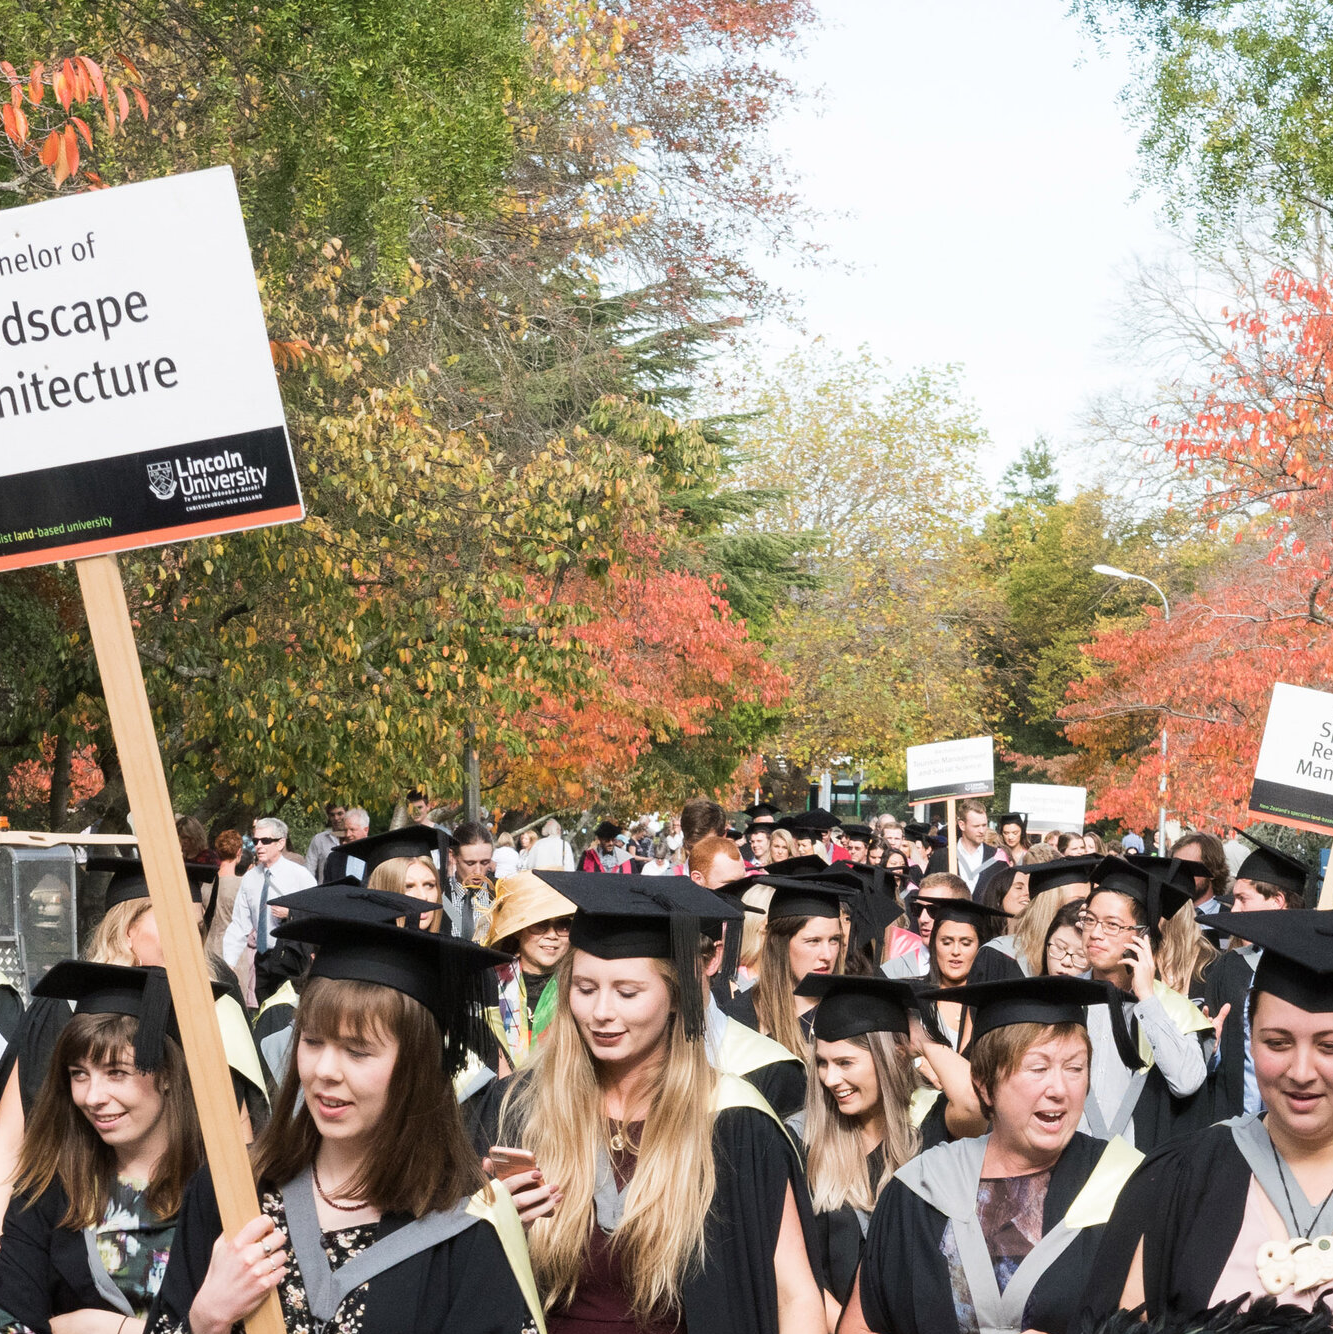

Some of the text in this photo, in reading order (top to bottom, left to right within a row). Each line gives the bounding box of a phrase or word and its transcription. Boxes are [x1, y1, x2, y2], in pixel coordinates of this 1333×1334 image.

[71, 232, 97, 261] of
[175, 450, 244, 478] Lincoln
[179, 465, 267, 496] University
[14, 522, 65, 542] land-based
[67, 516, 113, 534] university
